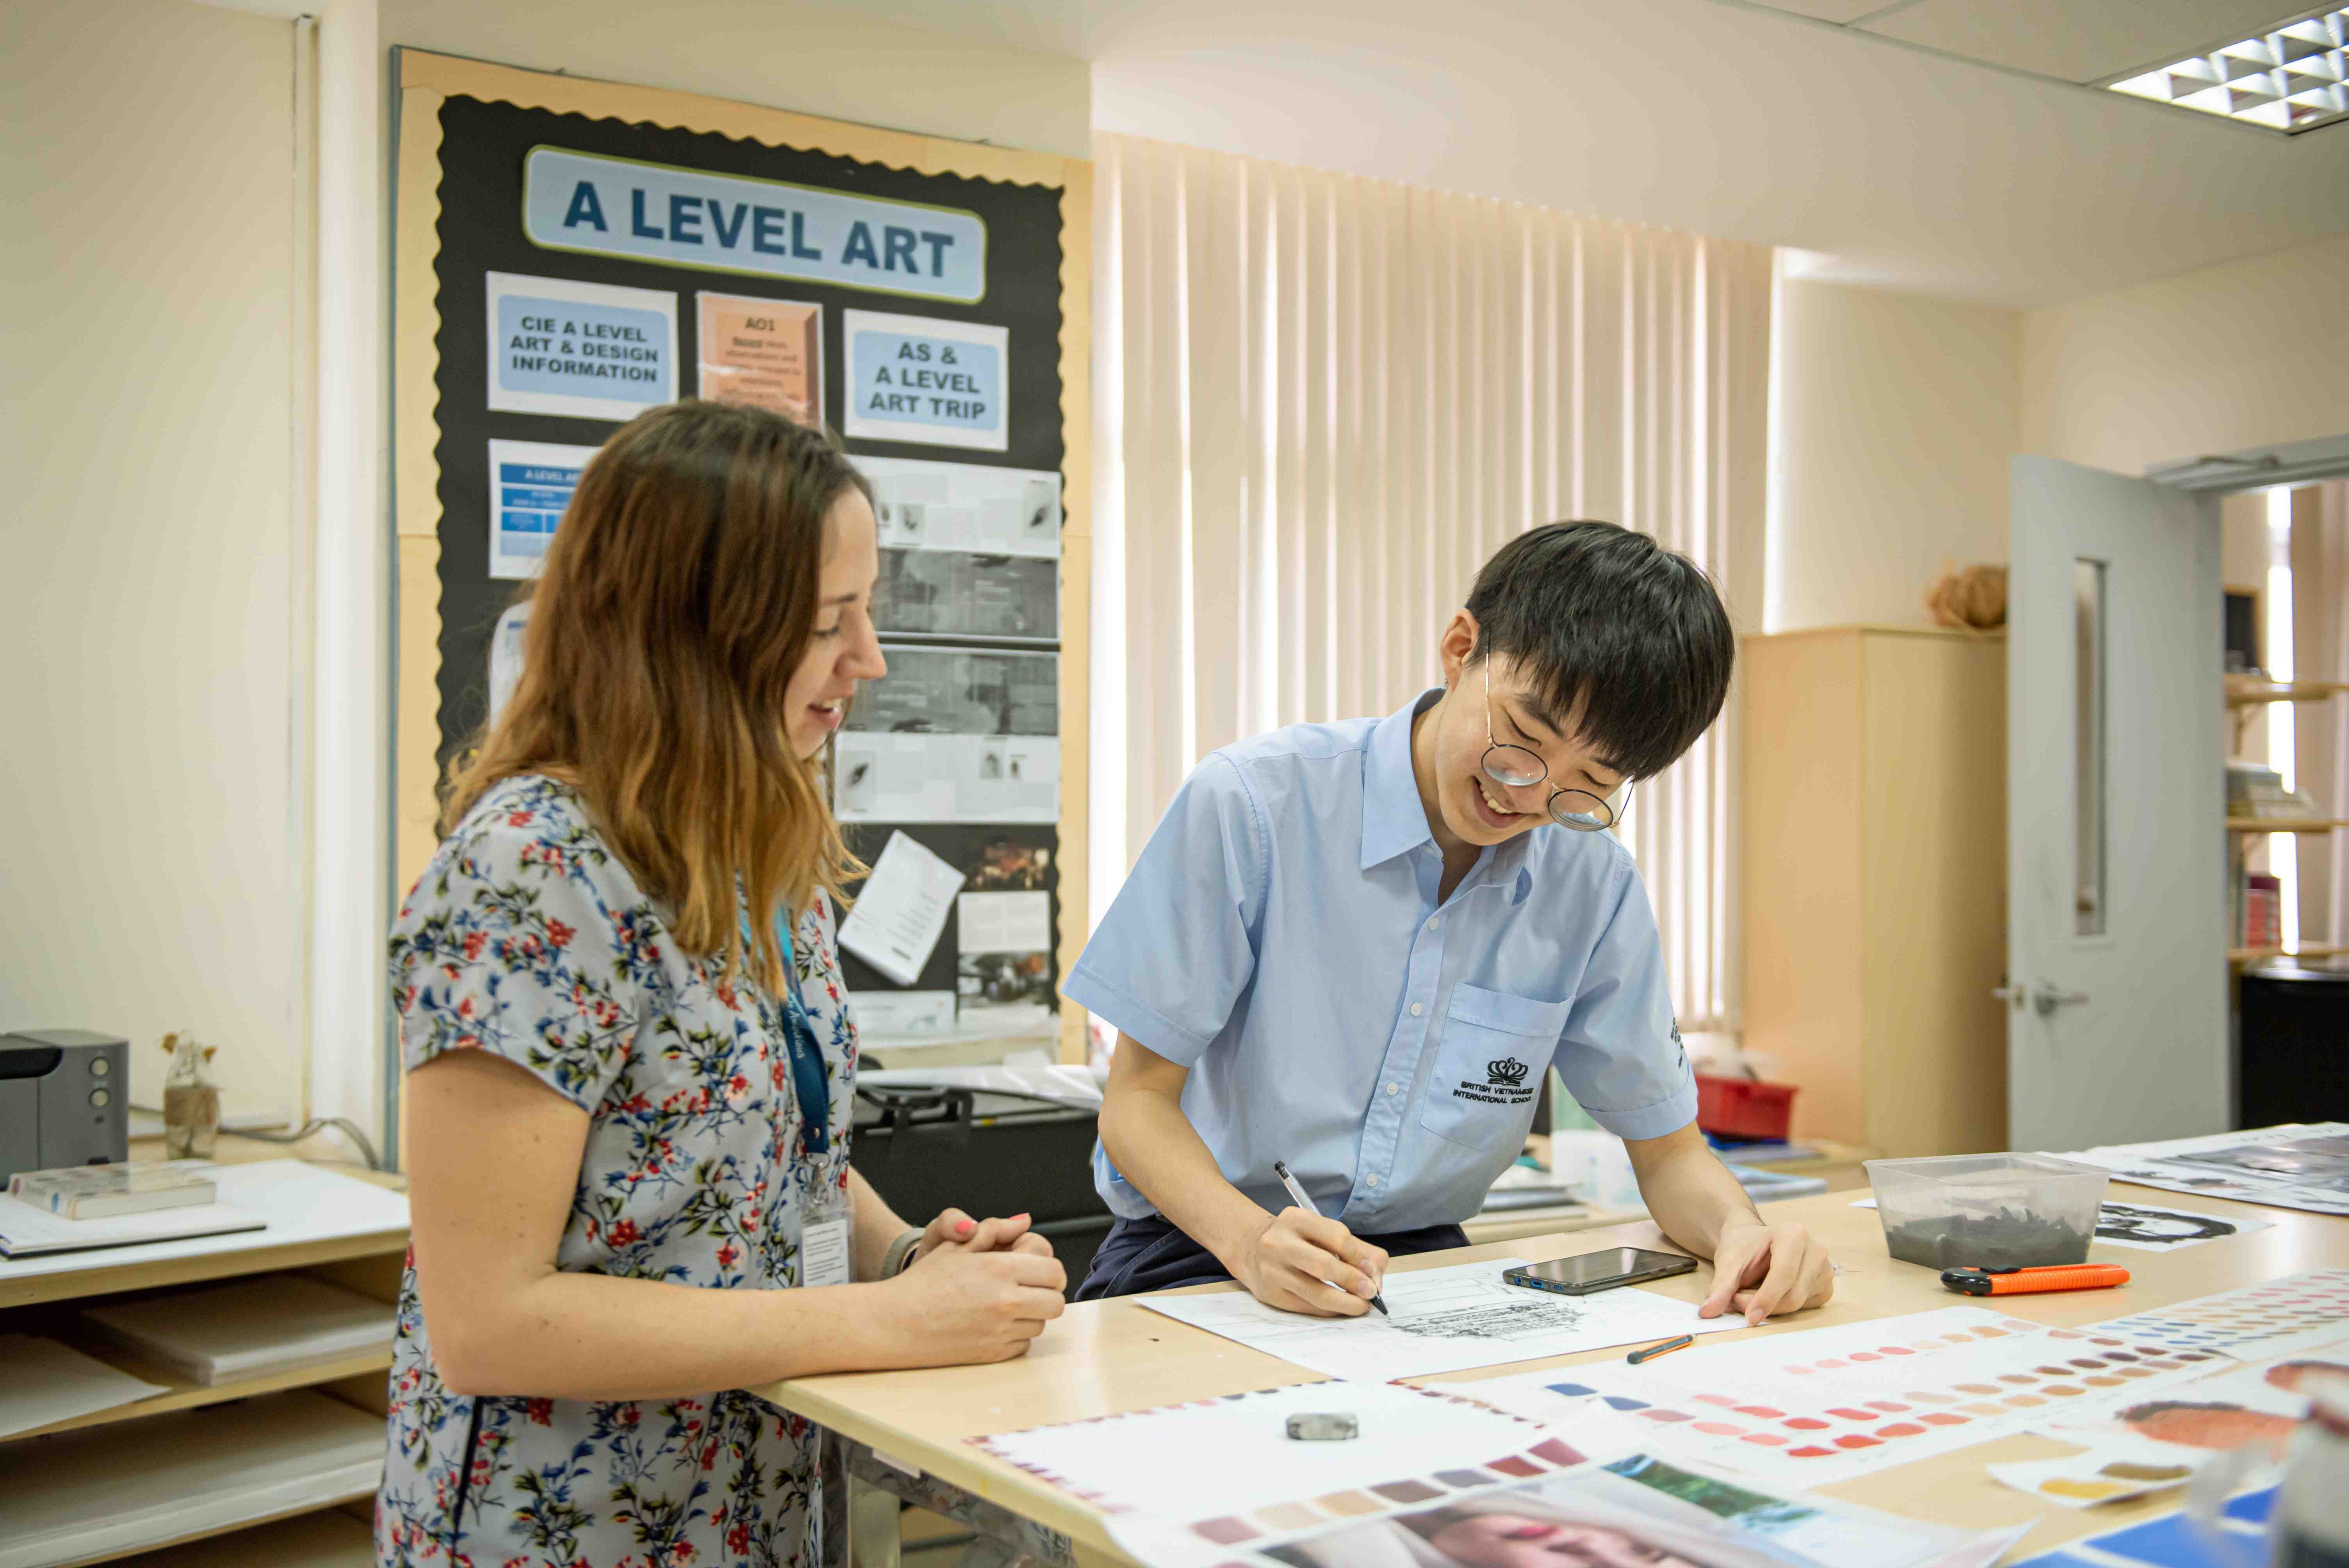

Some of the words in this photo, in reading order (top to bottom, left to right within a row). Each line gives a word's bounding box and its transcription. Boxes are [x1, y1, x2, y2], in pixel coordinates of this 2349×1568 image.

[563, 181, 608, 232] A
[631, 189, 822, 261] LEVEL
[841, 220, 954, 278] ART
[521, 315, 556, 332] CIE
[563, 321, 577, 335] A
[583, 323, 647, 342] LEVEL
[745, 317, 775, 332] AO1
[510, 335, 552, 352] ART
[560, 340, 574, 354] &
[581, 342, 658, 363] DESIGN
[898, 342, 931, 362] AS
[941, 346, 958, 365] &
[512, 355, 658, 382] INFORMATION
[875, 365, 893, 385] A
[901, 368, 981, 394] LEVEL
[869, 392, 921, 413] ART
[928, 397, 986, 419] TRIP
[1453, 1089, 1508, 1104] INTERNATIONAL
[1510, 1096, 1532, 1104] SCHOO
[1461, 1081, 1491, 1093] BRITISH
